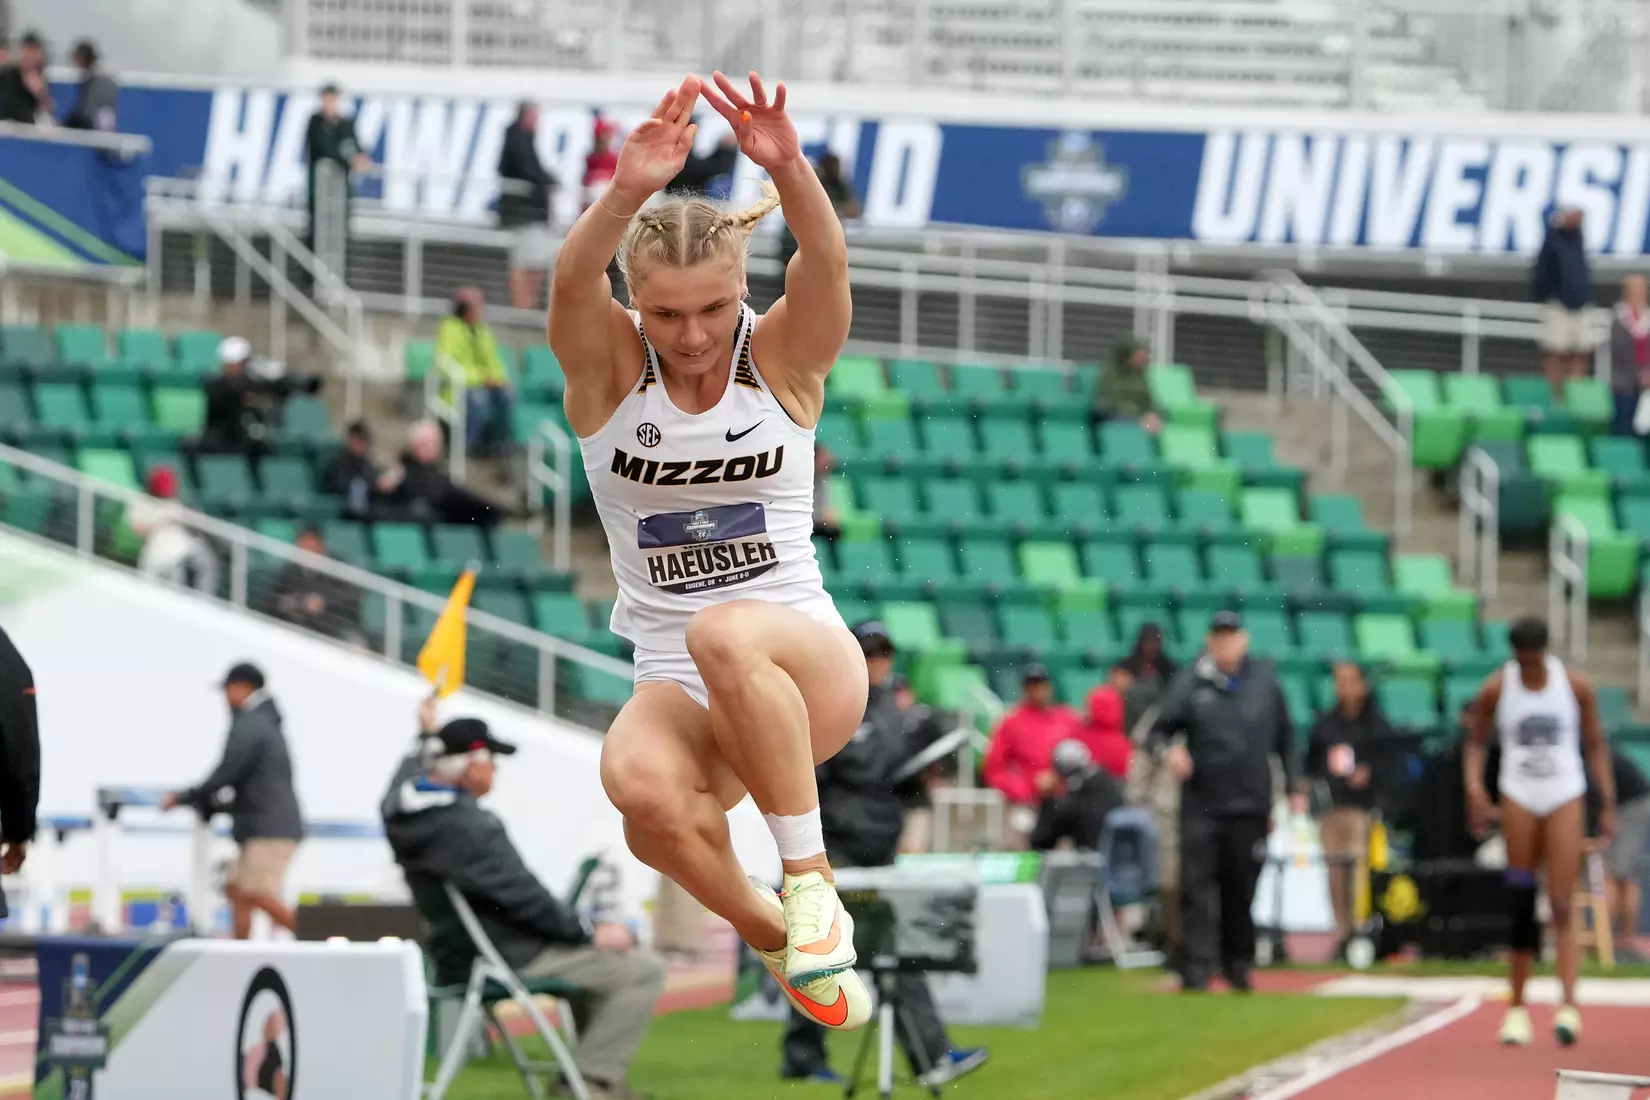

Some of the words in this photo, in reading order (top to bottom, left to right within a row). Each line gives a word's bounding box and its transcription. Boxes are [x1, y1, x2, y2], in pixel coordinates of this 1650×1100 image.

[638, 423, 660, 446] SEC
[611, 445, 784, 486] MIZZOU
[647, 542, 777, 583] HAEUSLER
[685, 581, 706, 589] EUGENE,
[725, 574, 739, 582] JUNE
